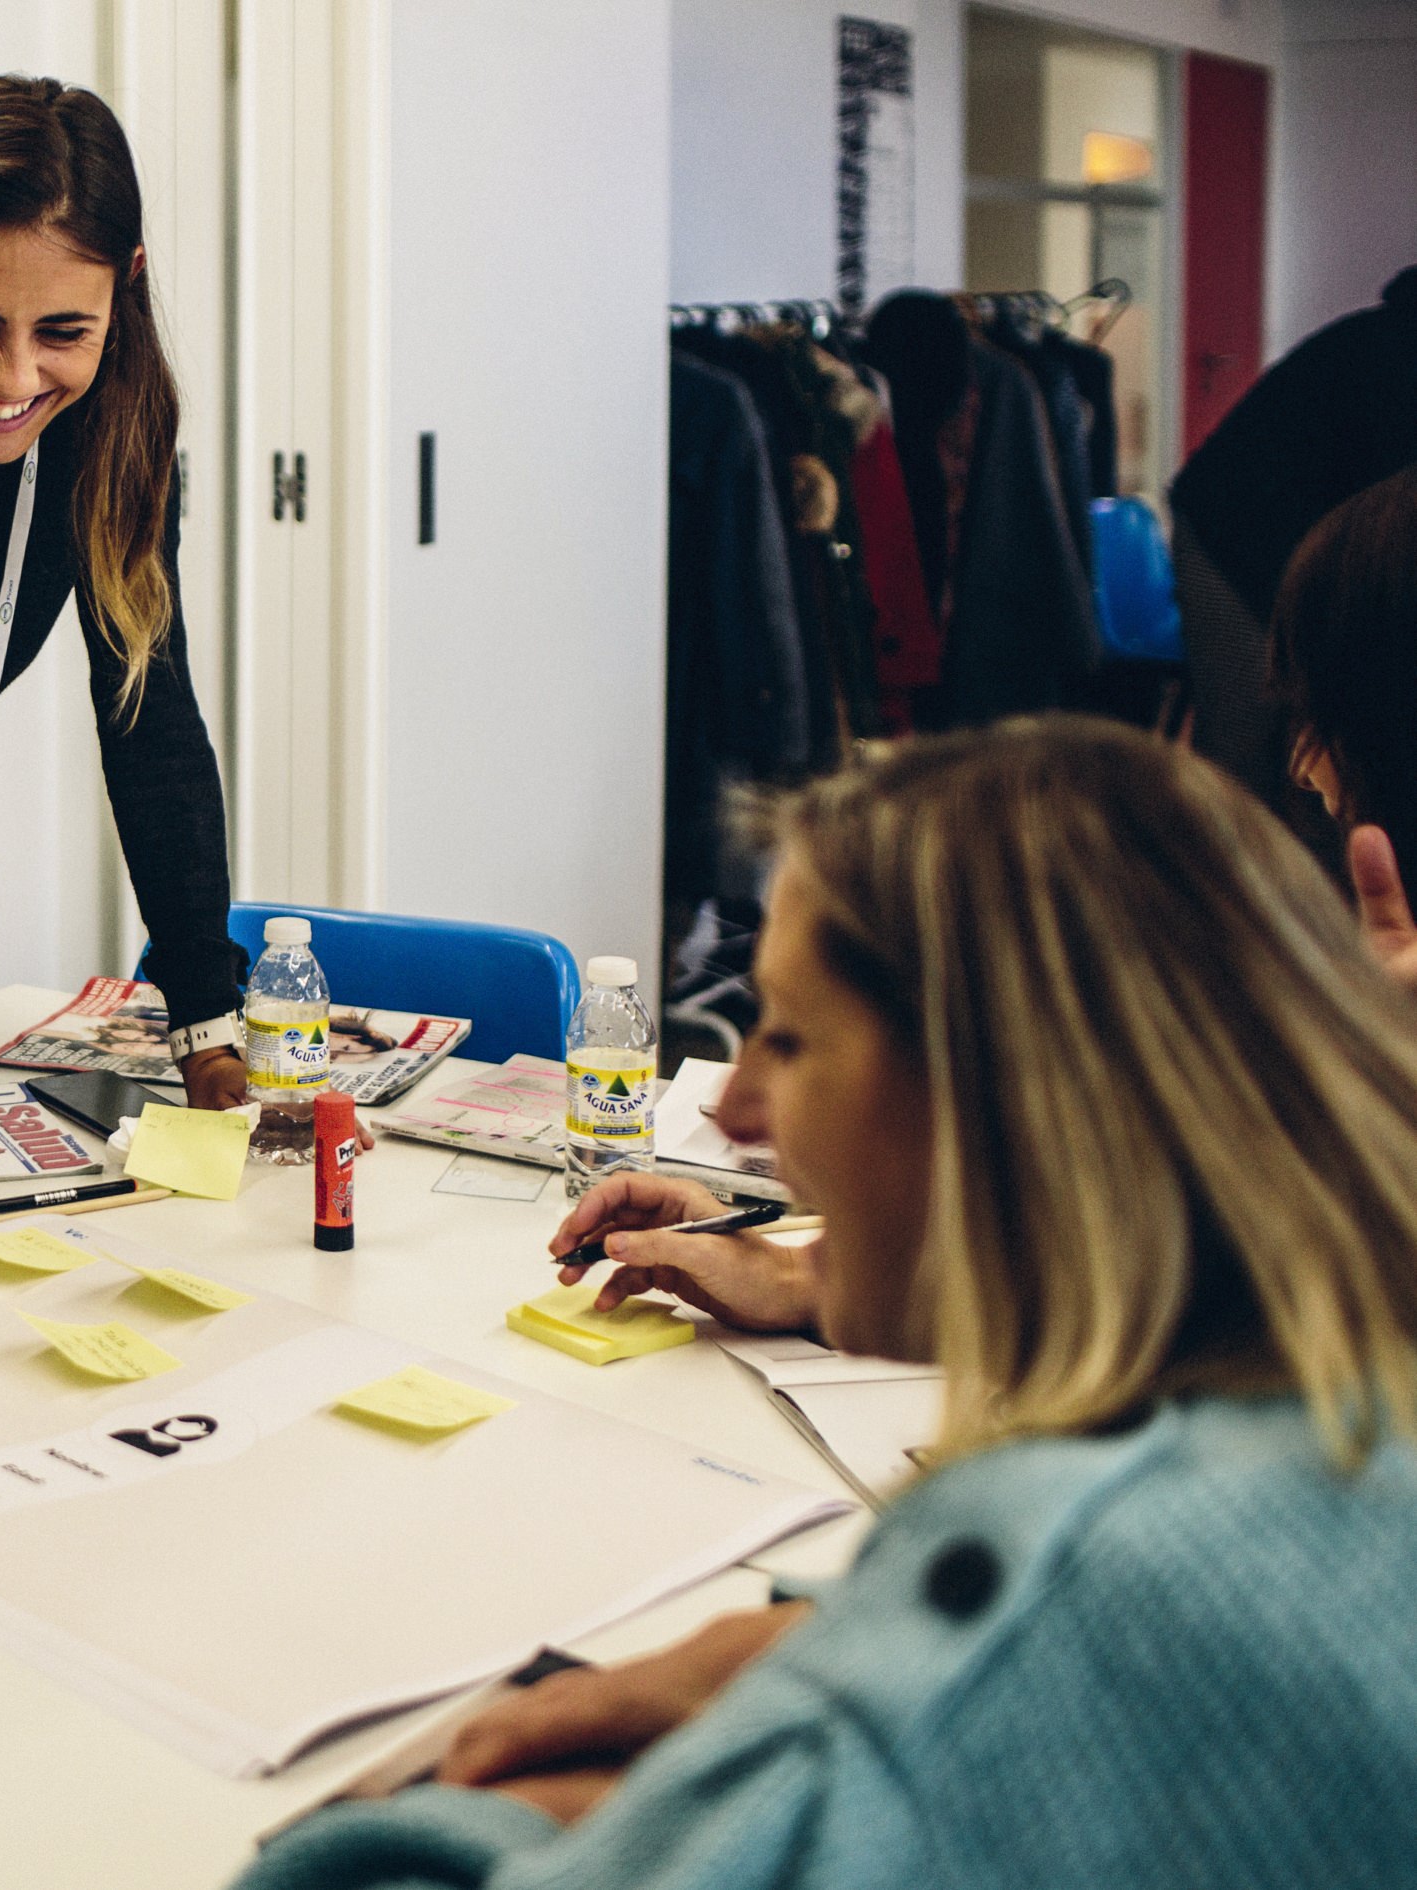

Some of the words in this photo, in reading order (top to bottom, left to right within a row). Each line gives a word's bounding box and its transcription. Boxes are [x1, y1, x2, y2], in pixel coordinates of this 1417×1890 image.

[287, 1046, 317, 1062] AGUA
[584, 1092, 617, 1114] AGUA
[619, 1092, 648, 1114] SANA
